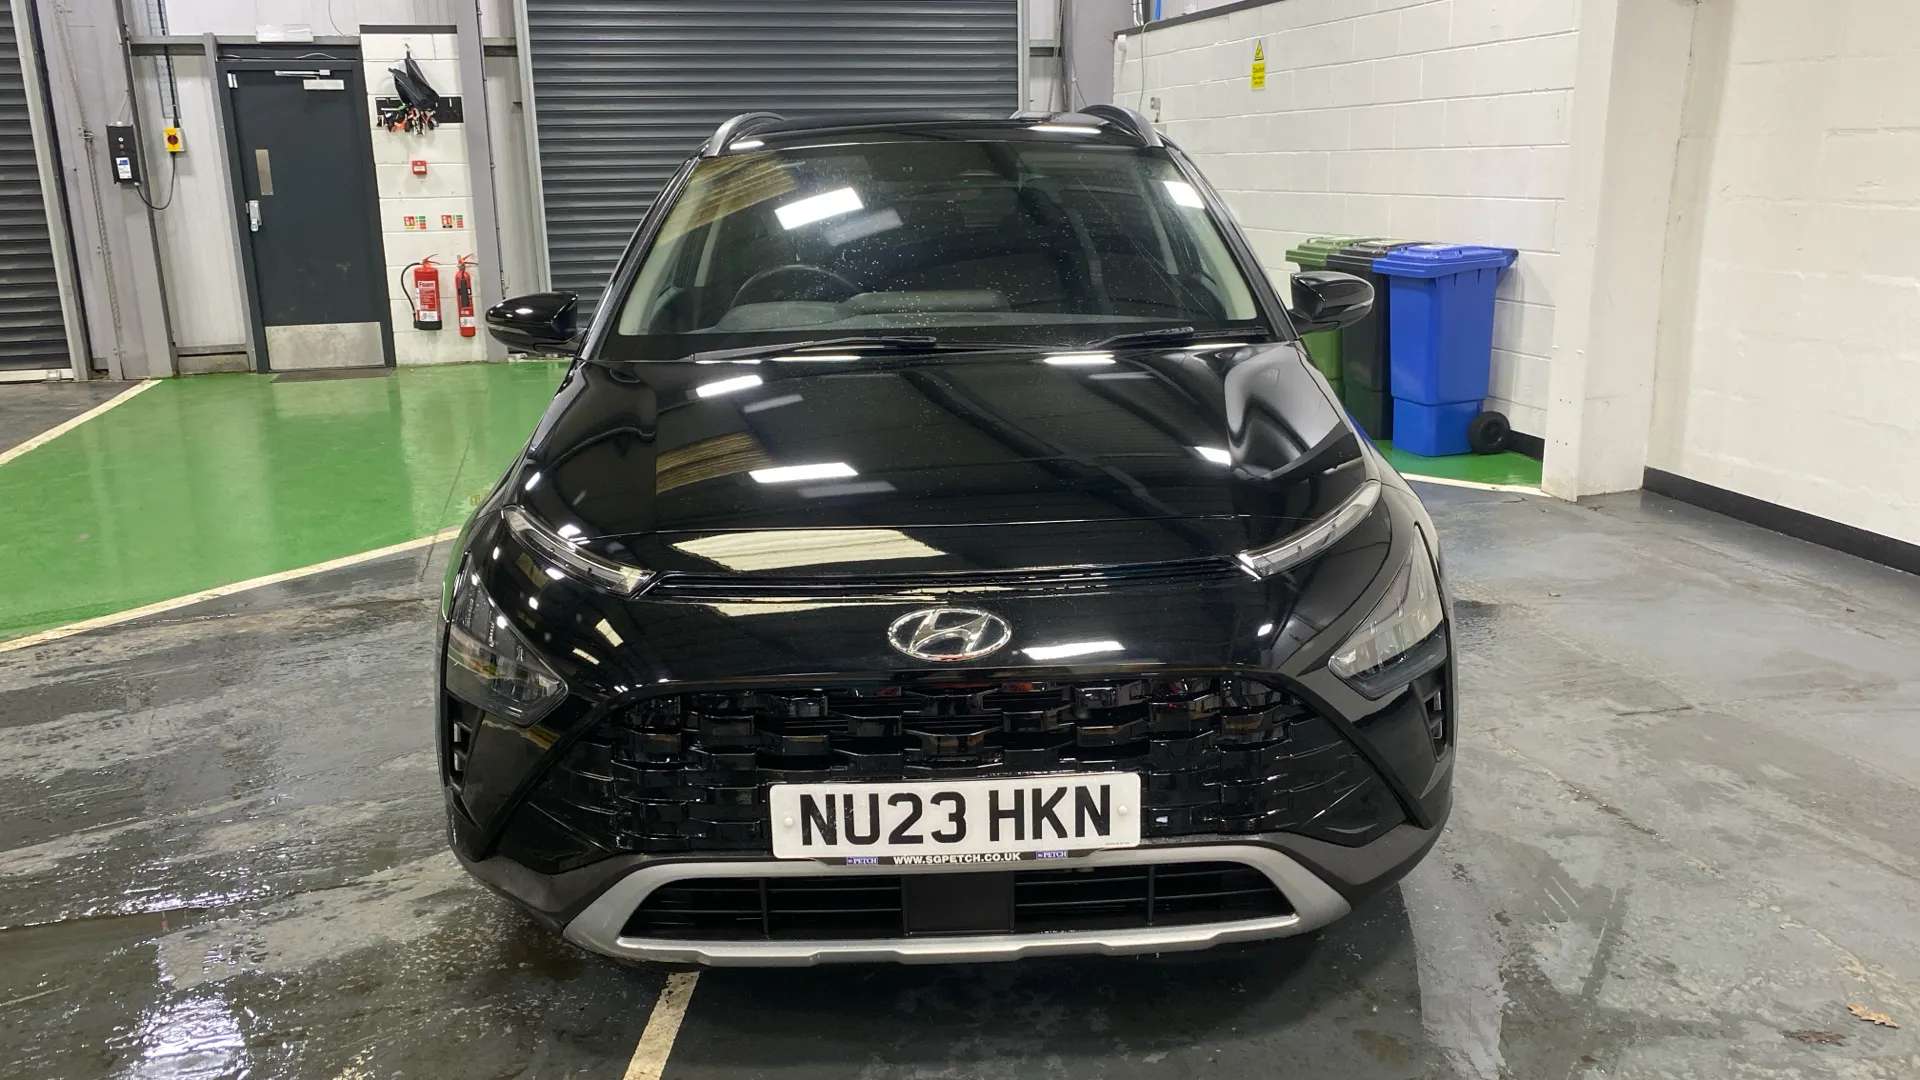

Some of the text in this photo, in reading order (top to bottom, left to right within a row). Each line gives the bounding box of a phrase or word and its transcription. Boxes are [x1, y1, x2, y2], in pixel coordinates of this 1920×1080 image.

[801, 784, 1111, 845] NU23 HKN
[893, 852, 1020, 865] WWW.SGPETCH.CO.UK
